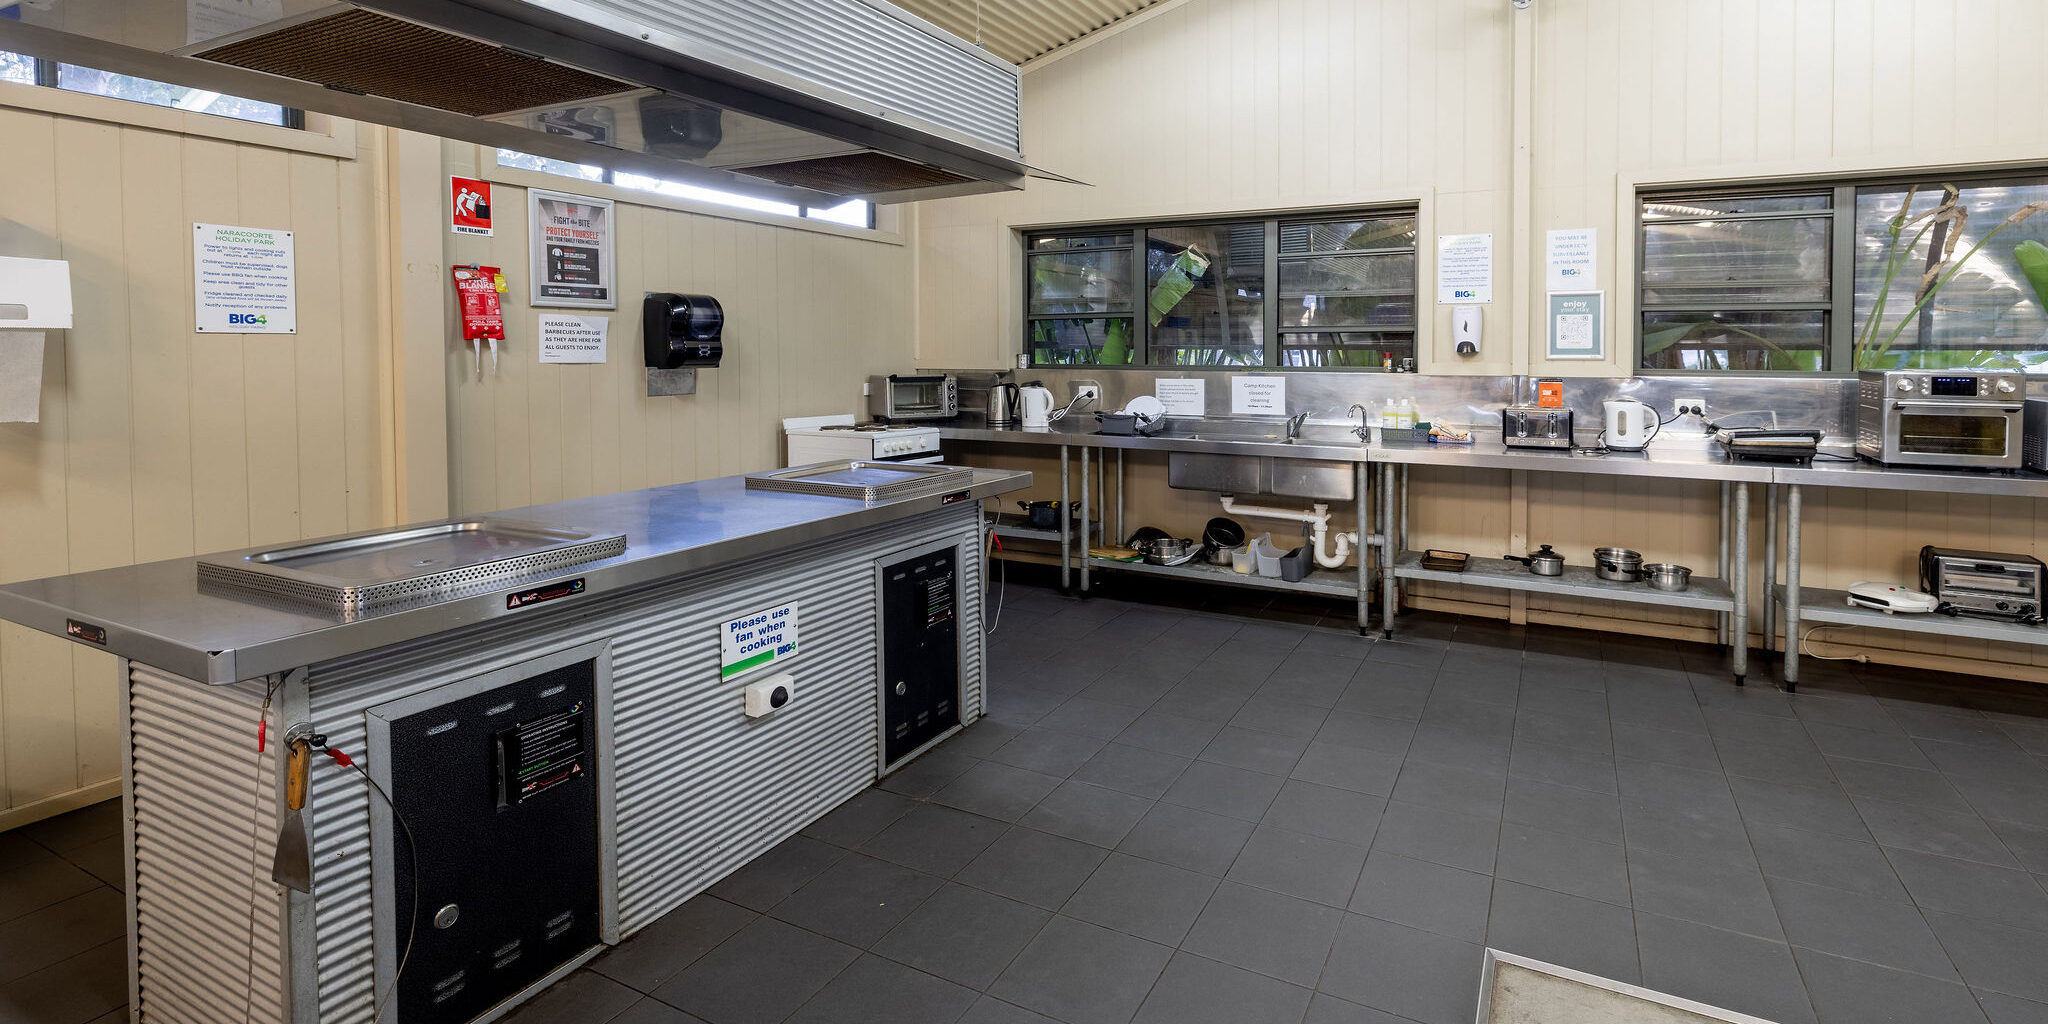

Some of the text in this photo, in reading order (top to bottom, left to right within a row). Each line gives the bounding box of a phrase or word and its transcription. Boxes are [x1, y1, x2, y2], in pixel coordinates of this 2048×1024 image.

[554, 216, 570, 225] FIGHT
[578, 219, 590, 227] BITE
[216, 229, 273, 239] NARACOORTE
[546, 227, 599, 240] PROTECT YOURSELF
[229, 314, 267, 324] BIG4
[730, 607, 789, 632] Please use
[736, 621, 786, 643] fan when
[740, 634, 782, 654] cooking
[777, 641, 796, 656] BIG4
